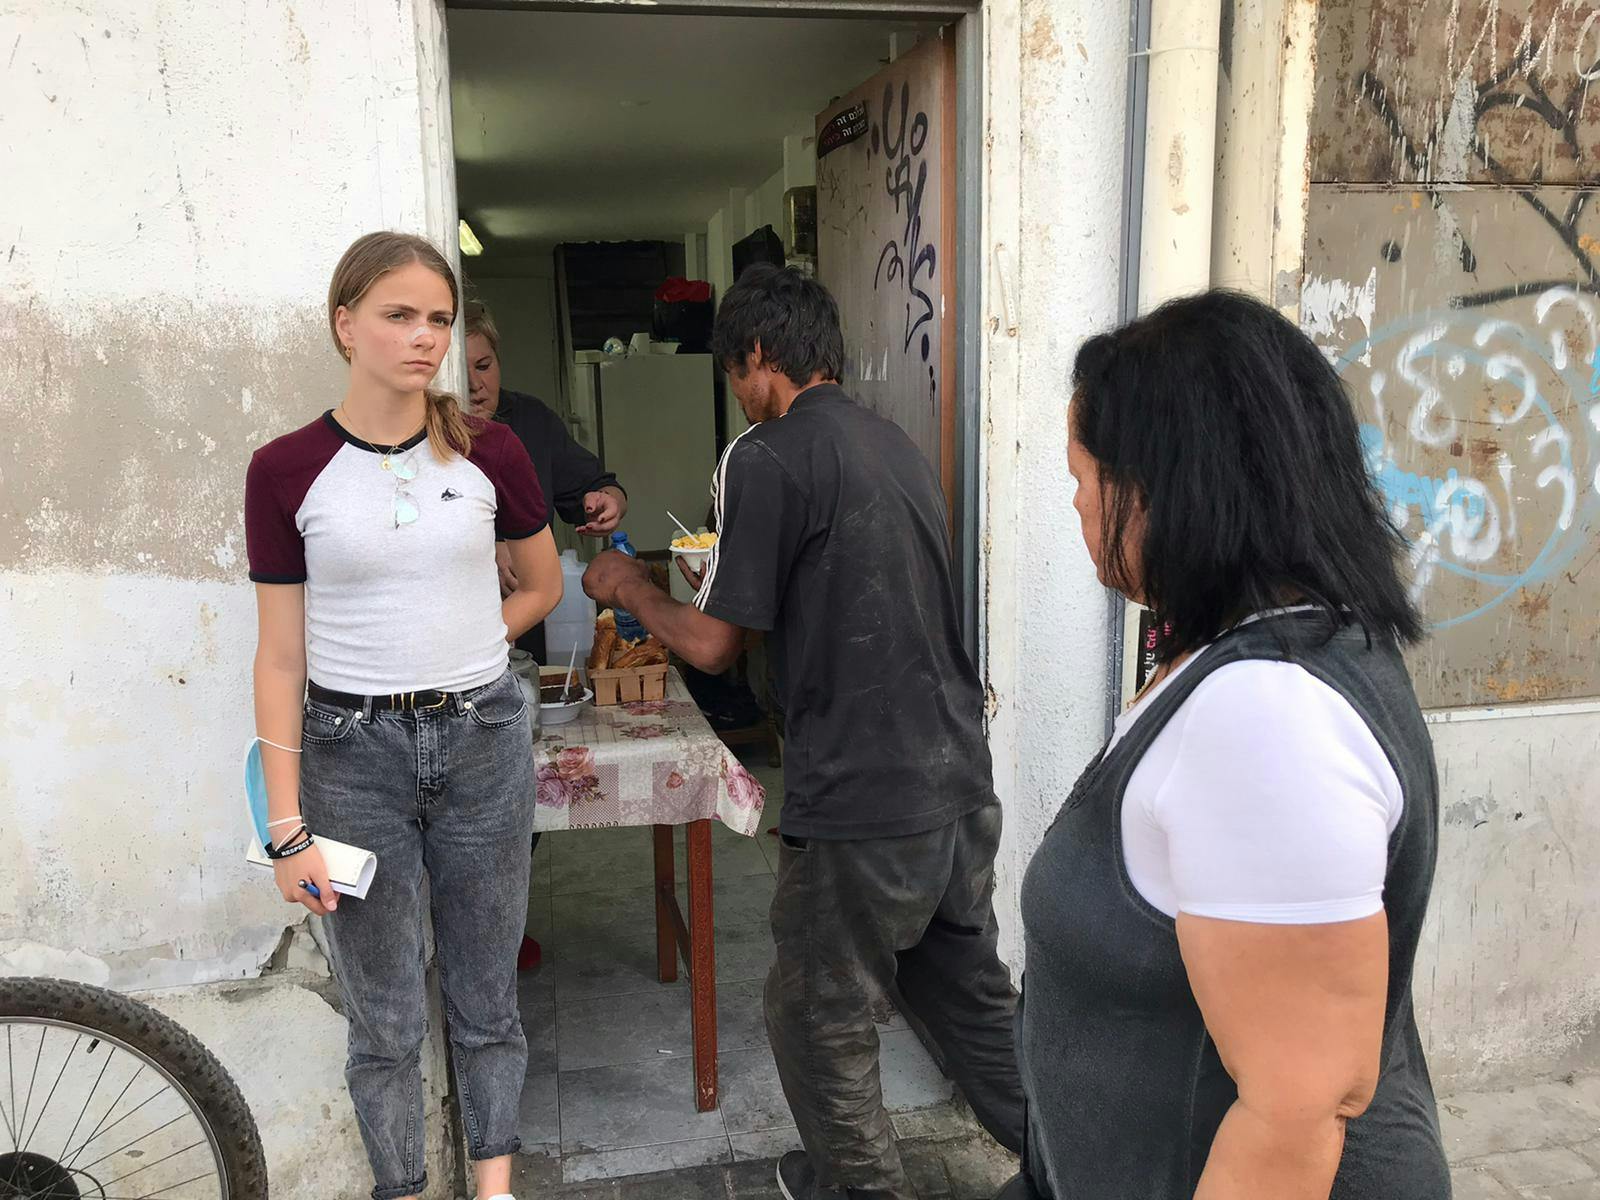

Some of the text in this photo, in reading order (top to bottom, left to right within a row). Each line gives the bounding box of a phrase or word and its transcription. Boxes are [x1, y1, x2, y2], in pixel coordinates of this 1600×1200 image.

[836, 115, 847, 126] זה
[842, 127, 852, 137] זה
[281, 841, 310, 856] RESPECT
